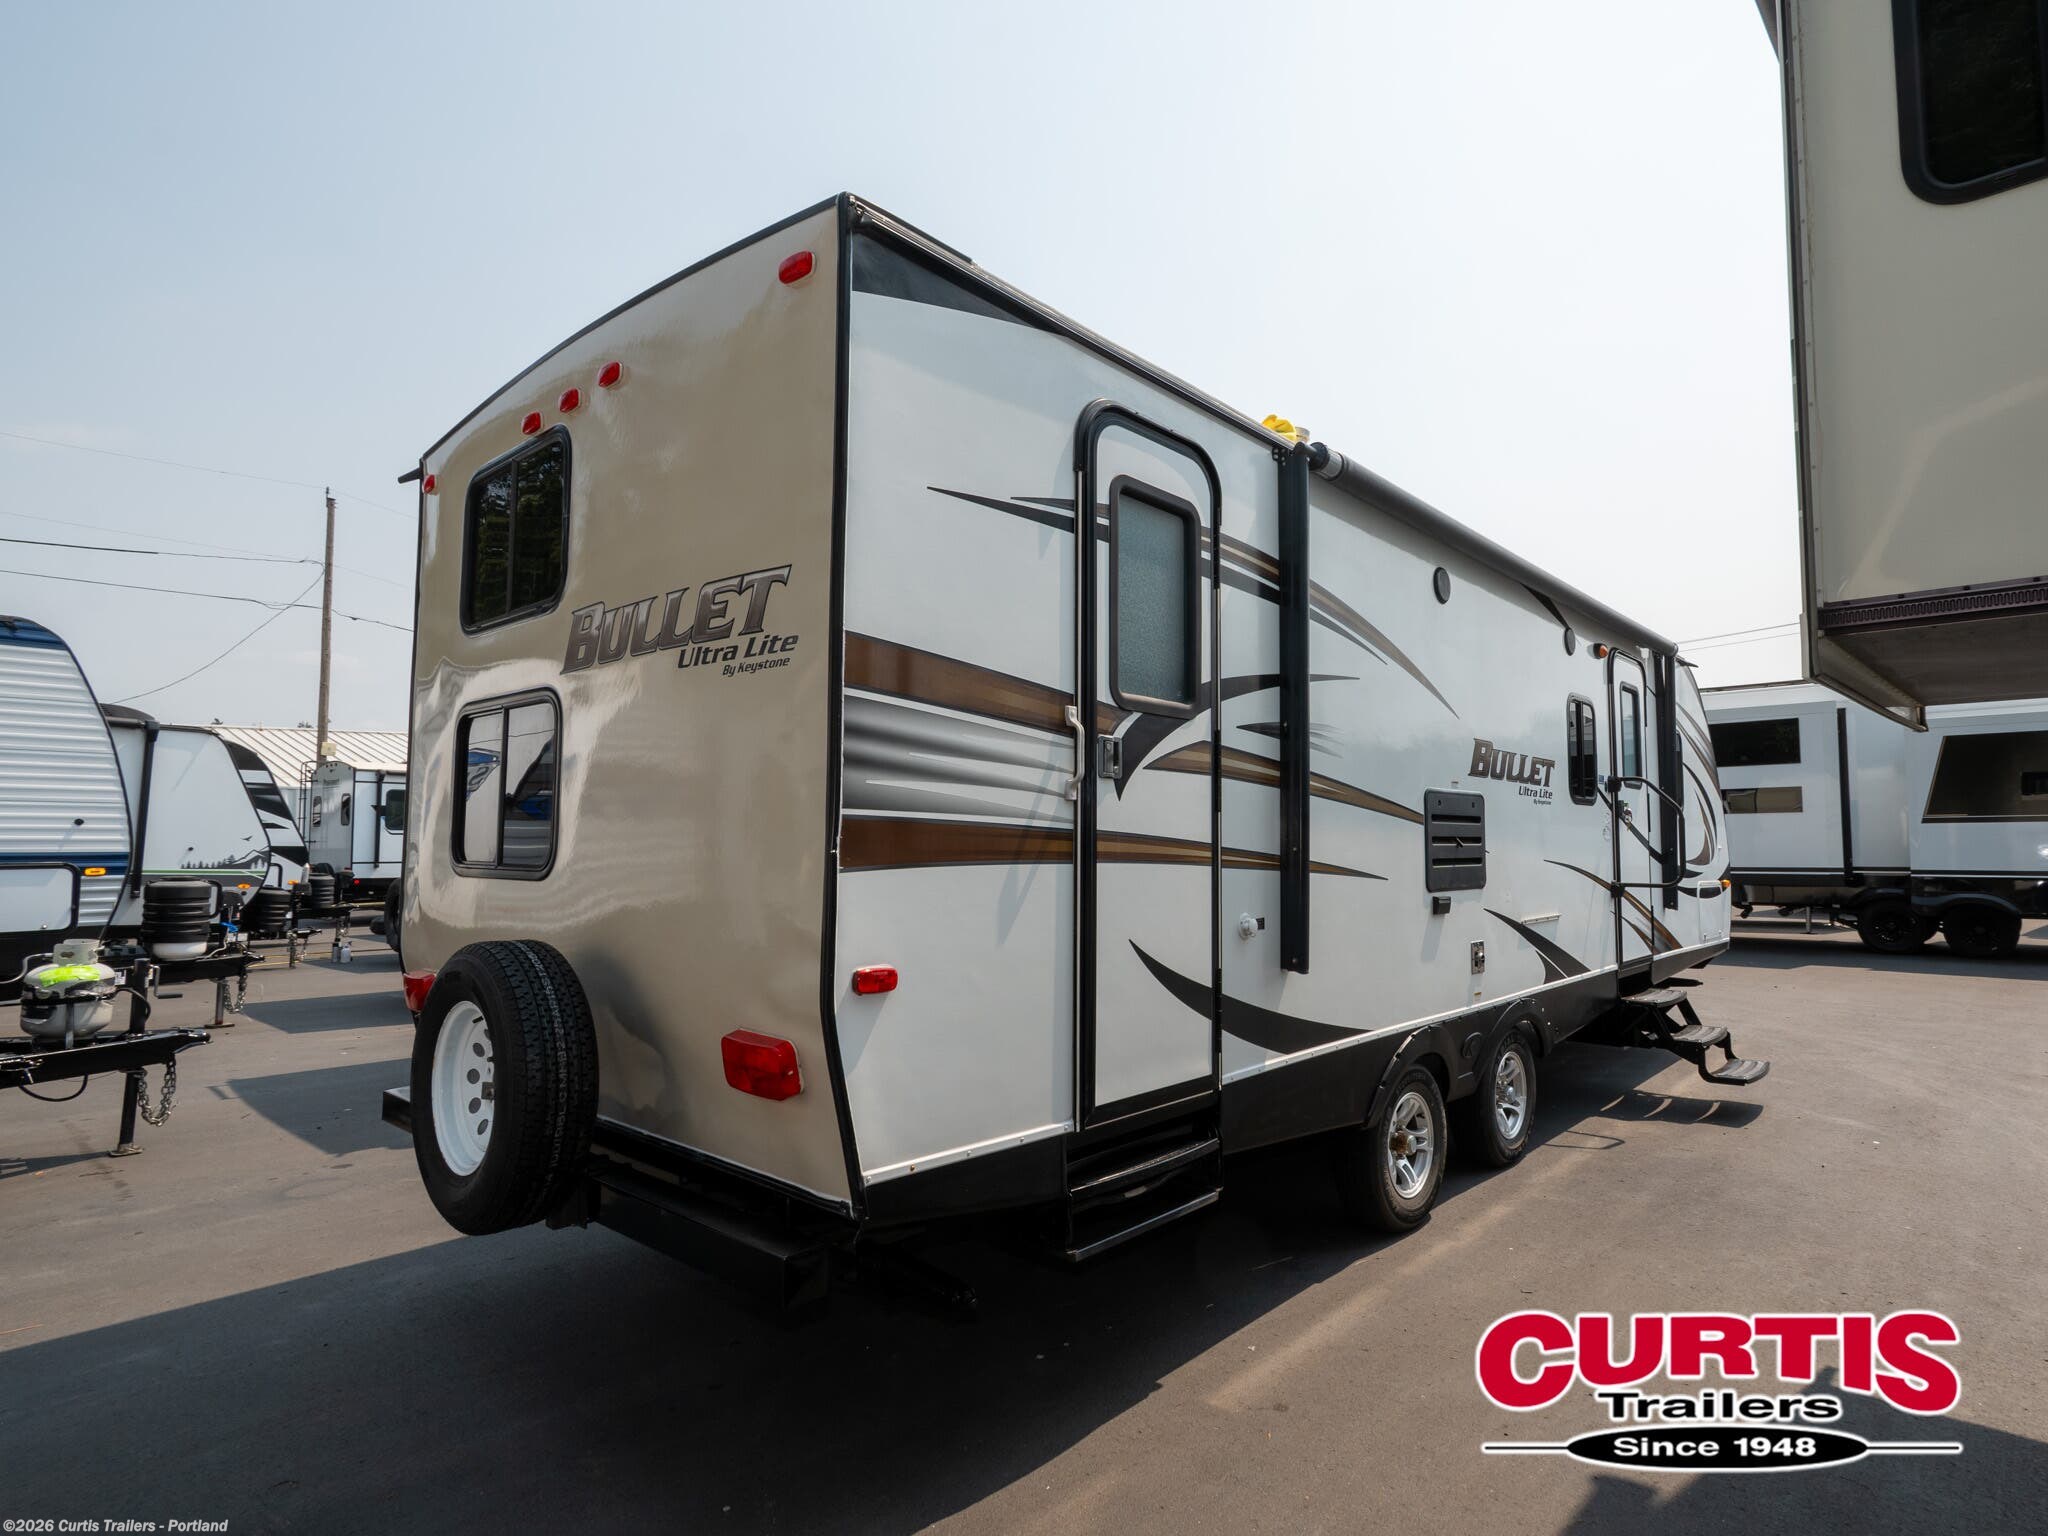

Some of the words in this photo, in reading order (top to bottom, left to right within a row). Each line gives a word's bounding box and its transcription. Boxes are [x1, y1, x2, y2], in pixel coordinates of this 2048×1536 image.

[560, 564, 792, 675] BULLET
[677, 645, 739, 669] Ultra
[743, 634, 799, 659] Lite
[722, 663, 736, 678] By
[737, 657, 791, 674] Keystone
[1468, 738, 1555, 788] BULLET
[1518, 785, 1538, 797] Ultra
[1539, 788, 1553, 800] Lite
